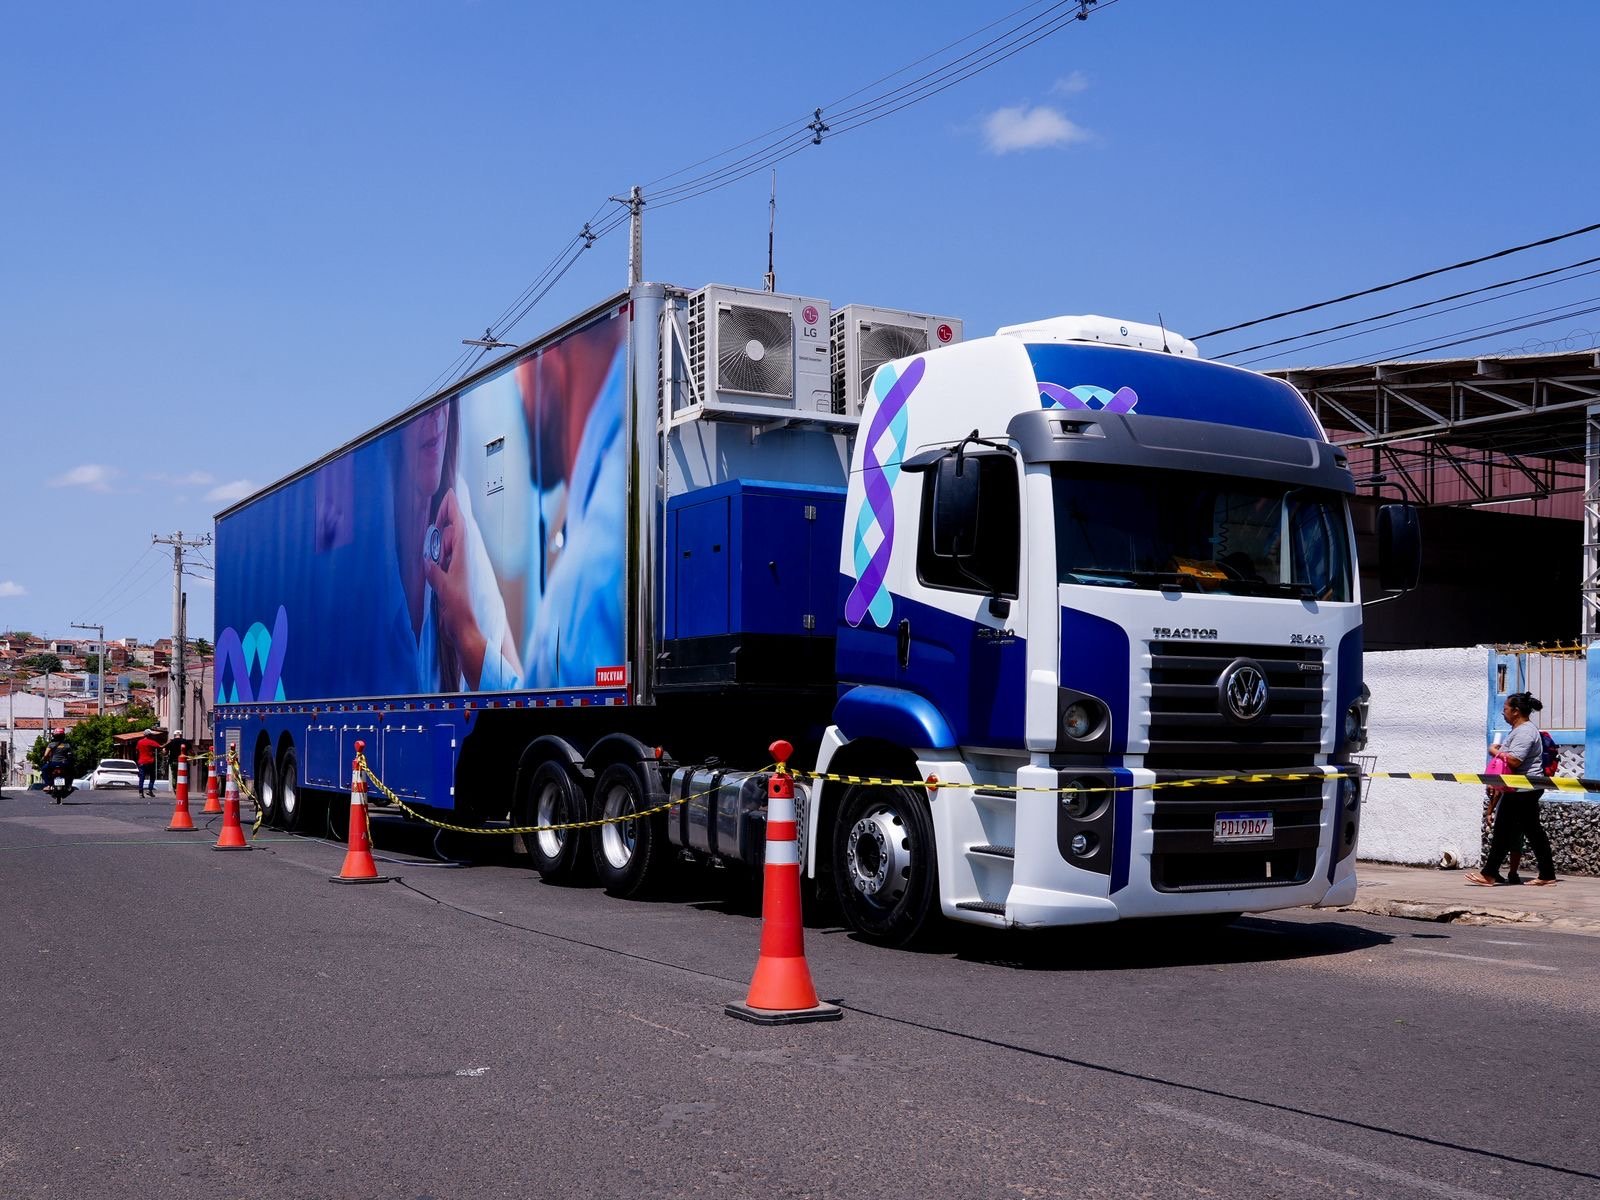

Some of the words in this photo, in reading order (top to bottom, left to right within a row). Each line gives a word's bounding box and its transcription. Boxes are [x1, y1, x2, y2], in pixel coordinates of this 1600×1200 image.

[804, 327, 817, 338] LG
[1153, 627, 1218, 640] TRACTOR
[597, 670, 624, 682] TRUCKVAN
